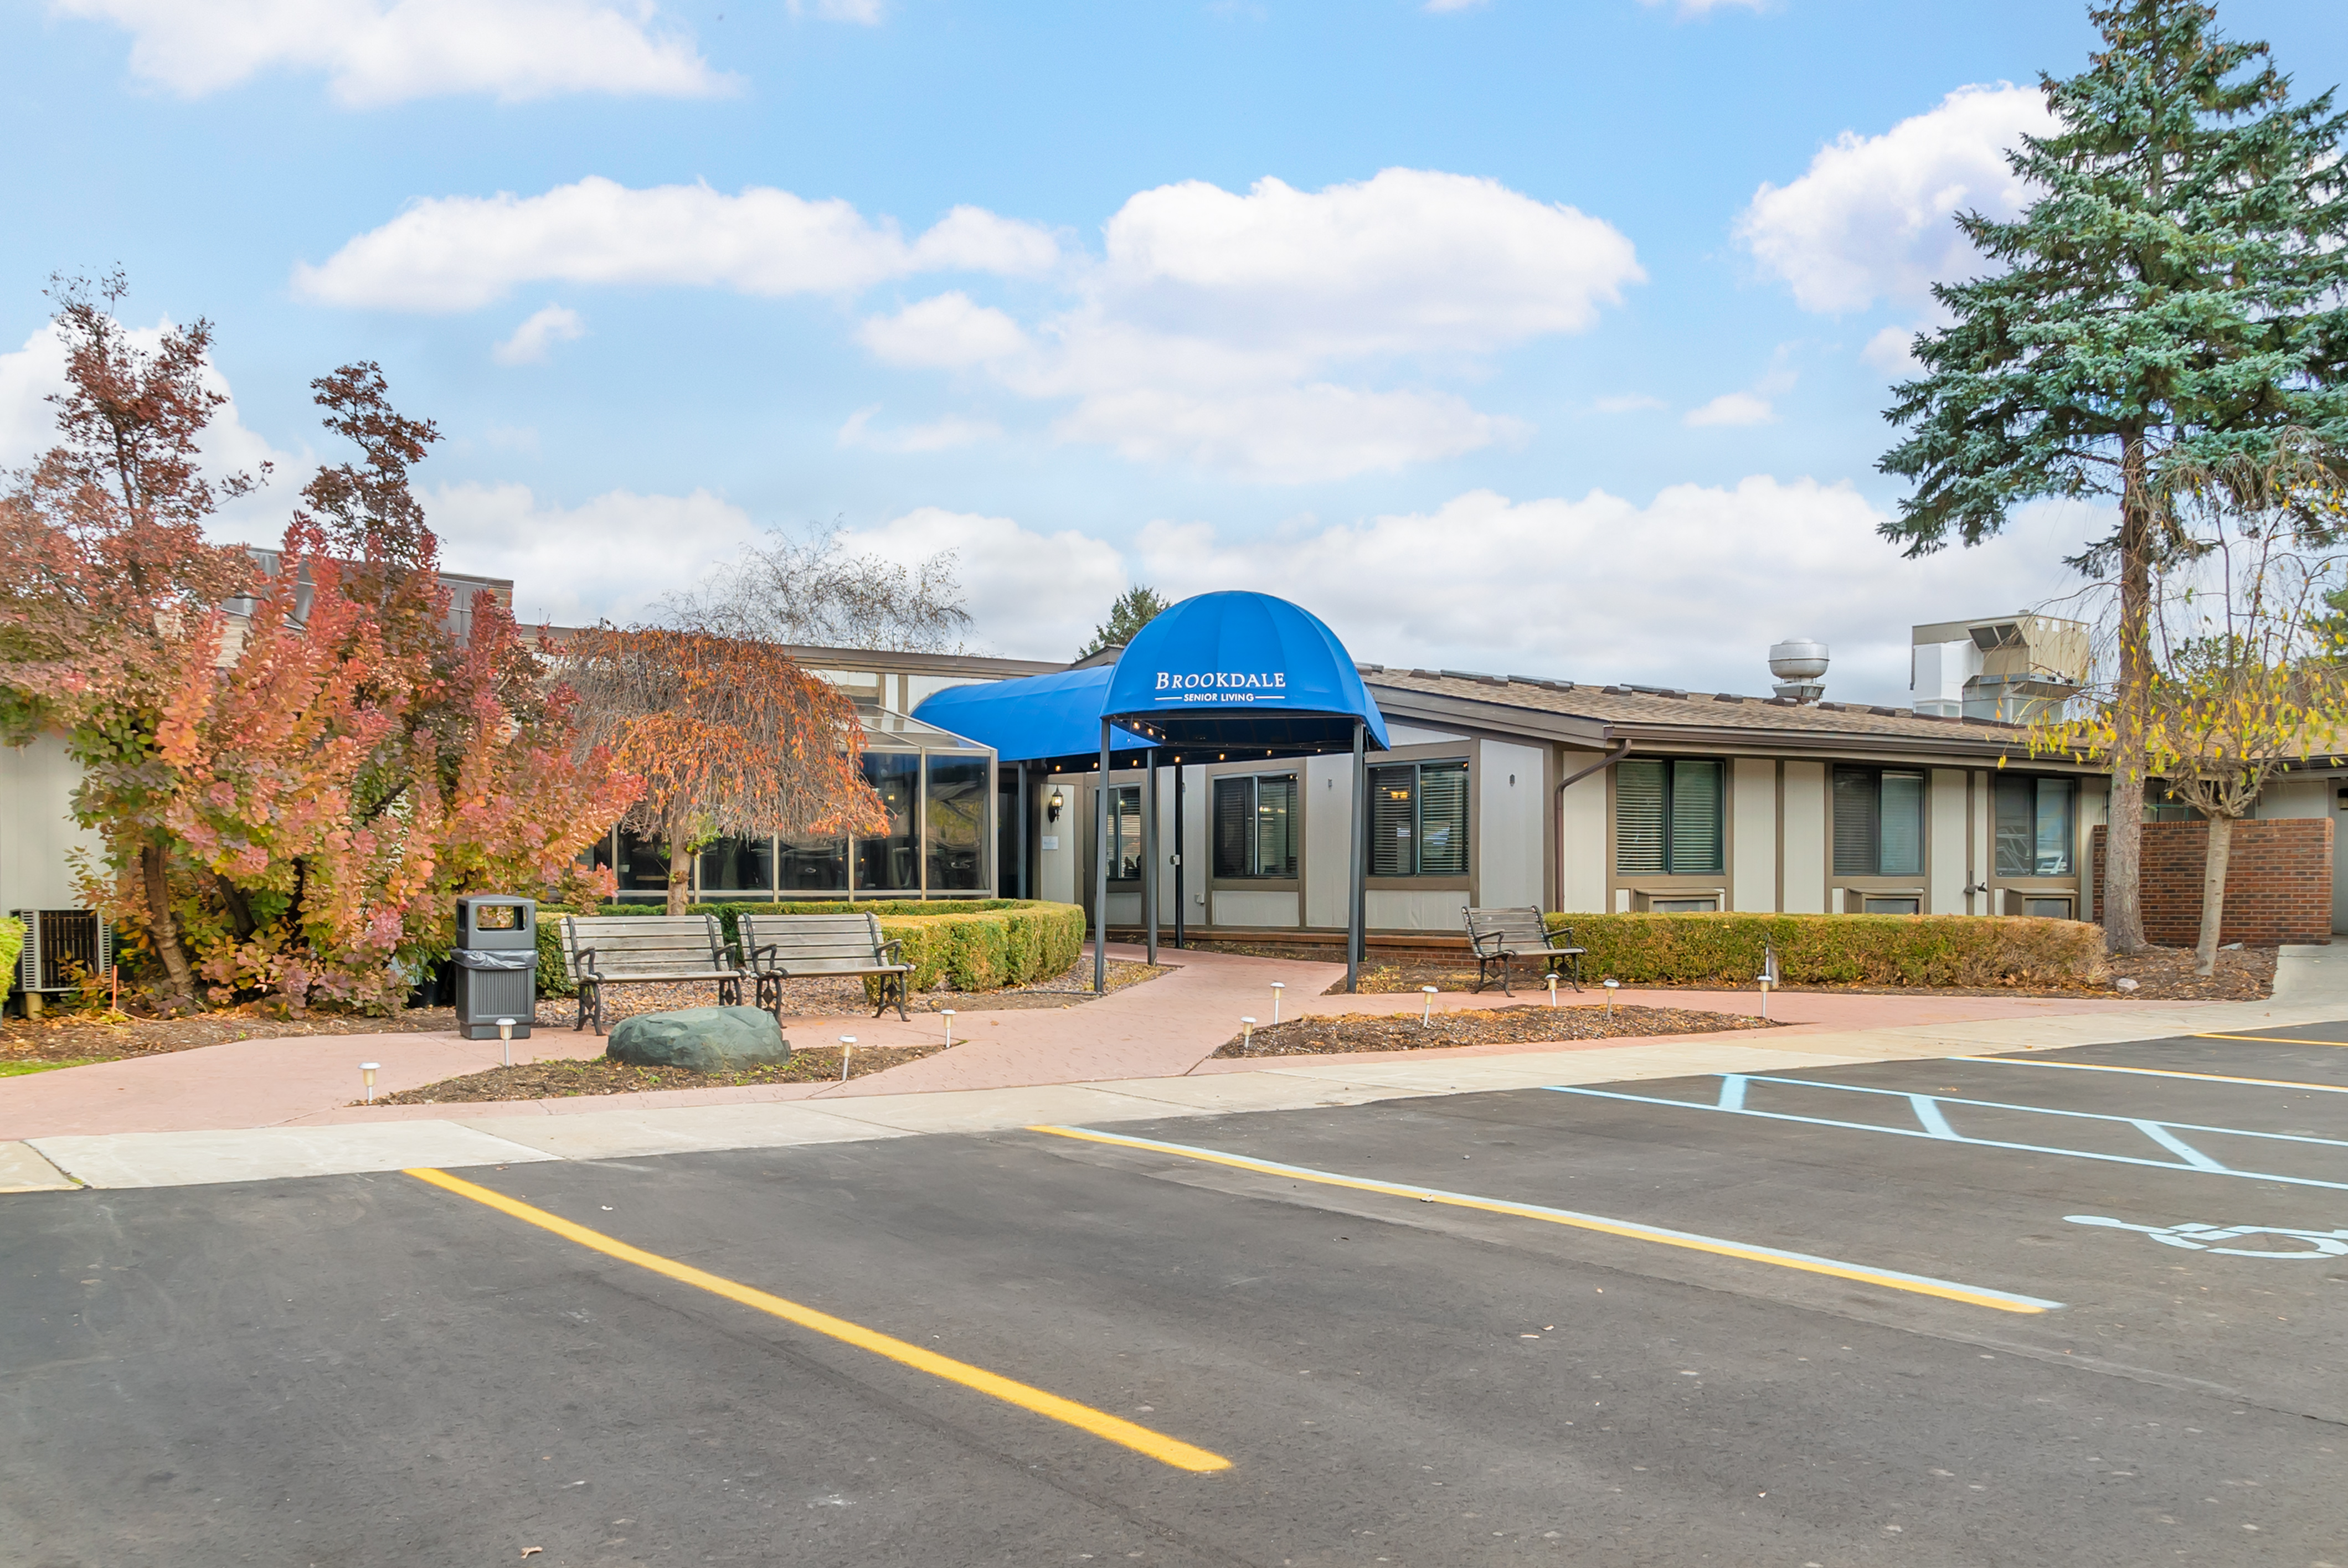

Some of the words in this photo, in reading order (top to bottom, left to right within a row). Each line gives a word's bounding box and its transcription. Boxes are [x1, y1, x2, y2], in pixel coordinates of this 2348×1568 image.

[1155, 672, 1286, 689] BROOKDALE
[1183, 693, 1218, 702] SENIOR
[1221, 693, 1254, 702] LIVING
